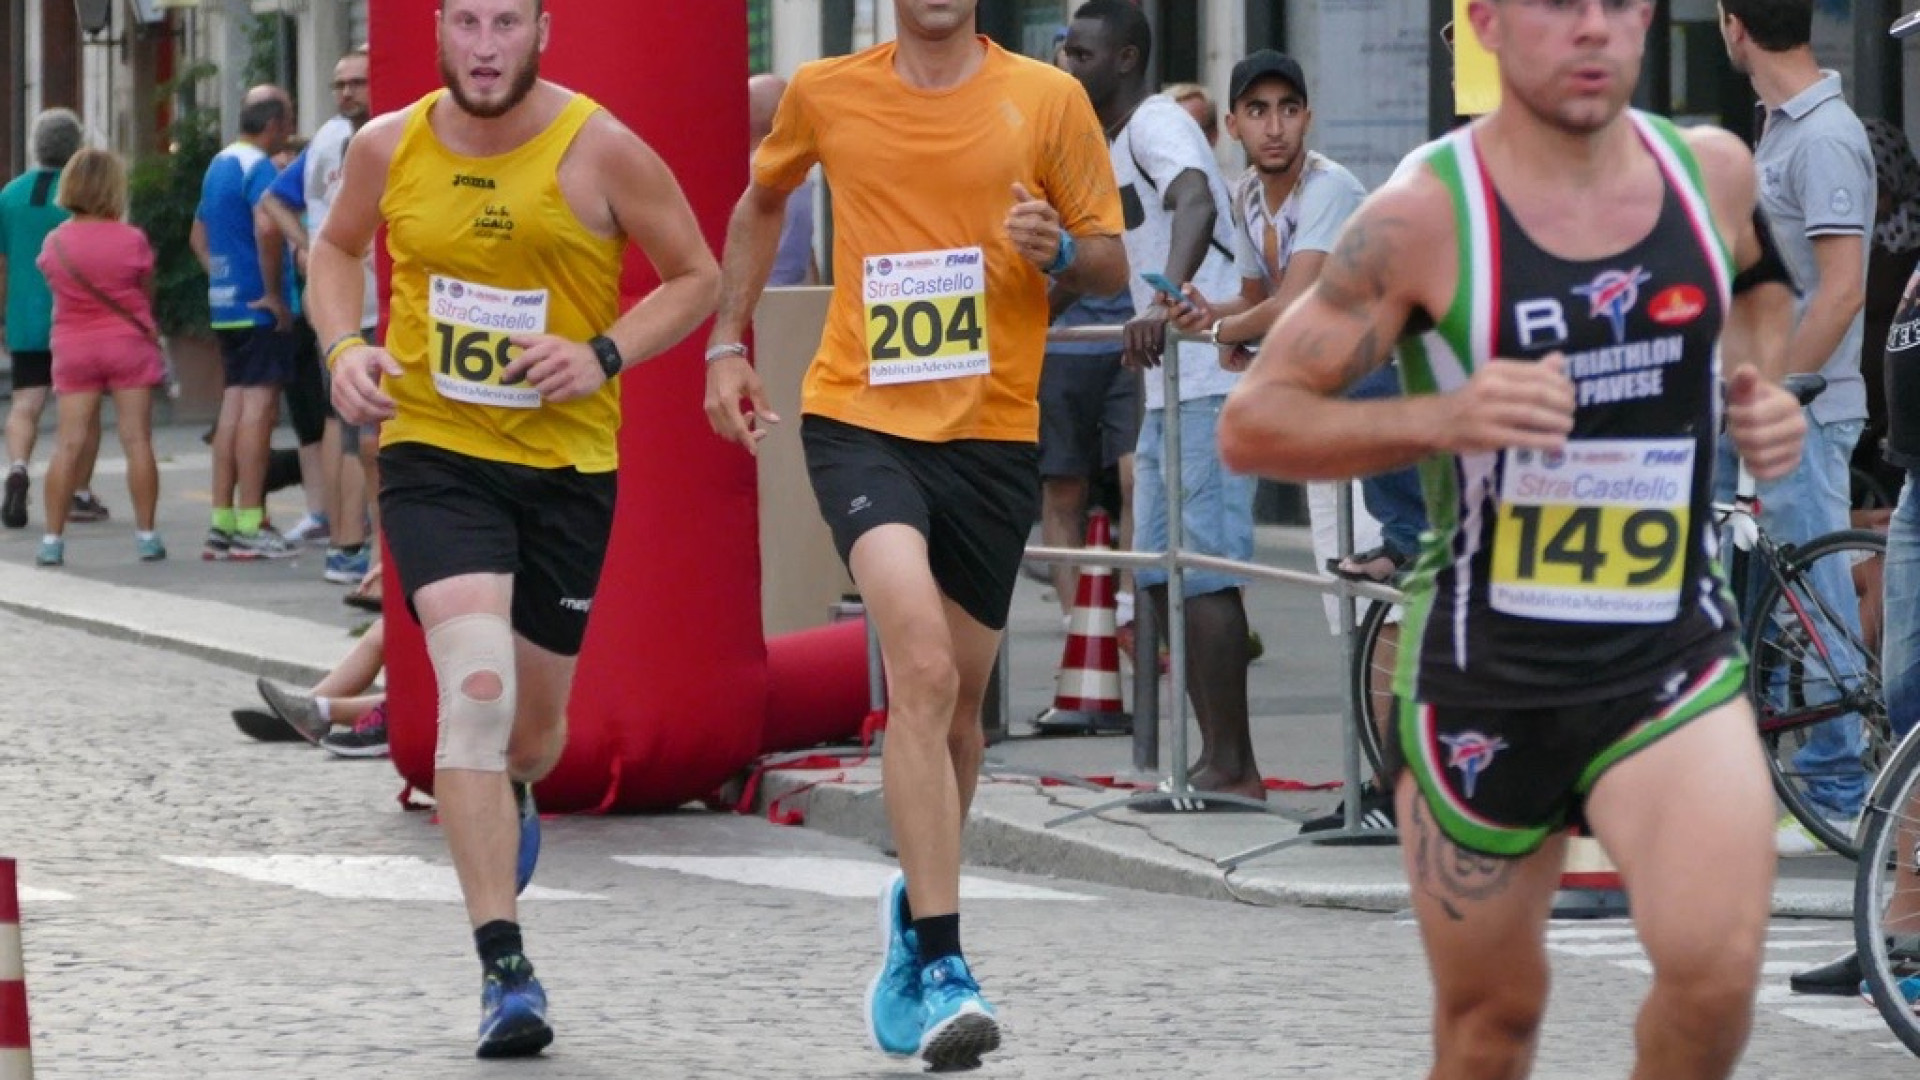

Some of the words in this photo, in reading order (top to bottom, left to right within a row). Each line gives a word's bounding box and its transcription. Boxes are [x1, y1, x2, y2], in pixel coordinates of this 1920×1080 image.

[868, 273, 974, 298] StraCastello
[435, 298, 536, 329] StraCastello
[871, 296, 982, 360] 204
[436, 321, 528, 386] 169
[1580, 367, 1664, 406] PAVESE
[1516, 473, 1679, 500] StraCastello
[1511, 504, 1680, 587] 149
